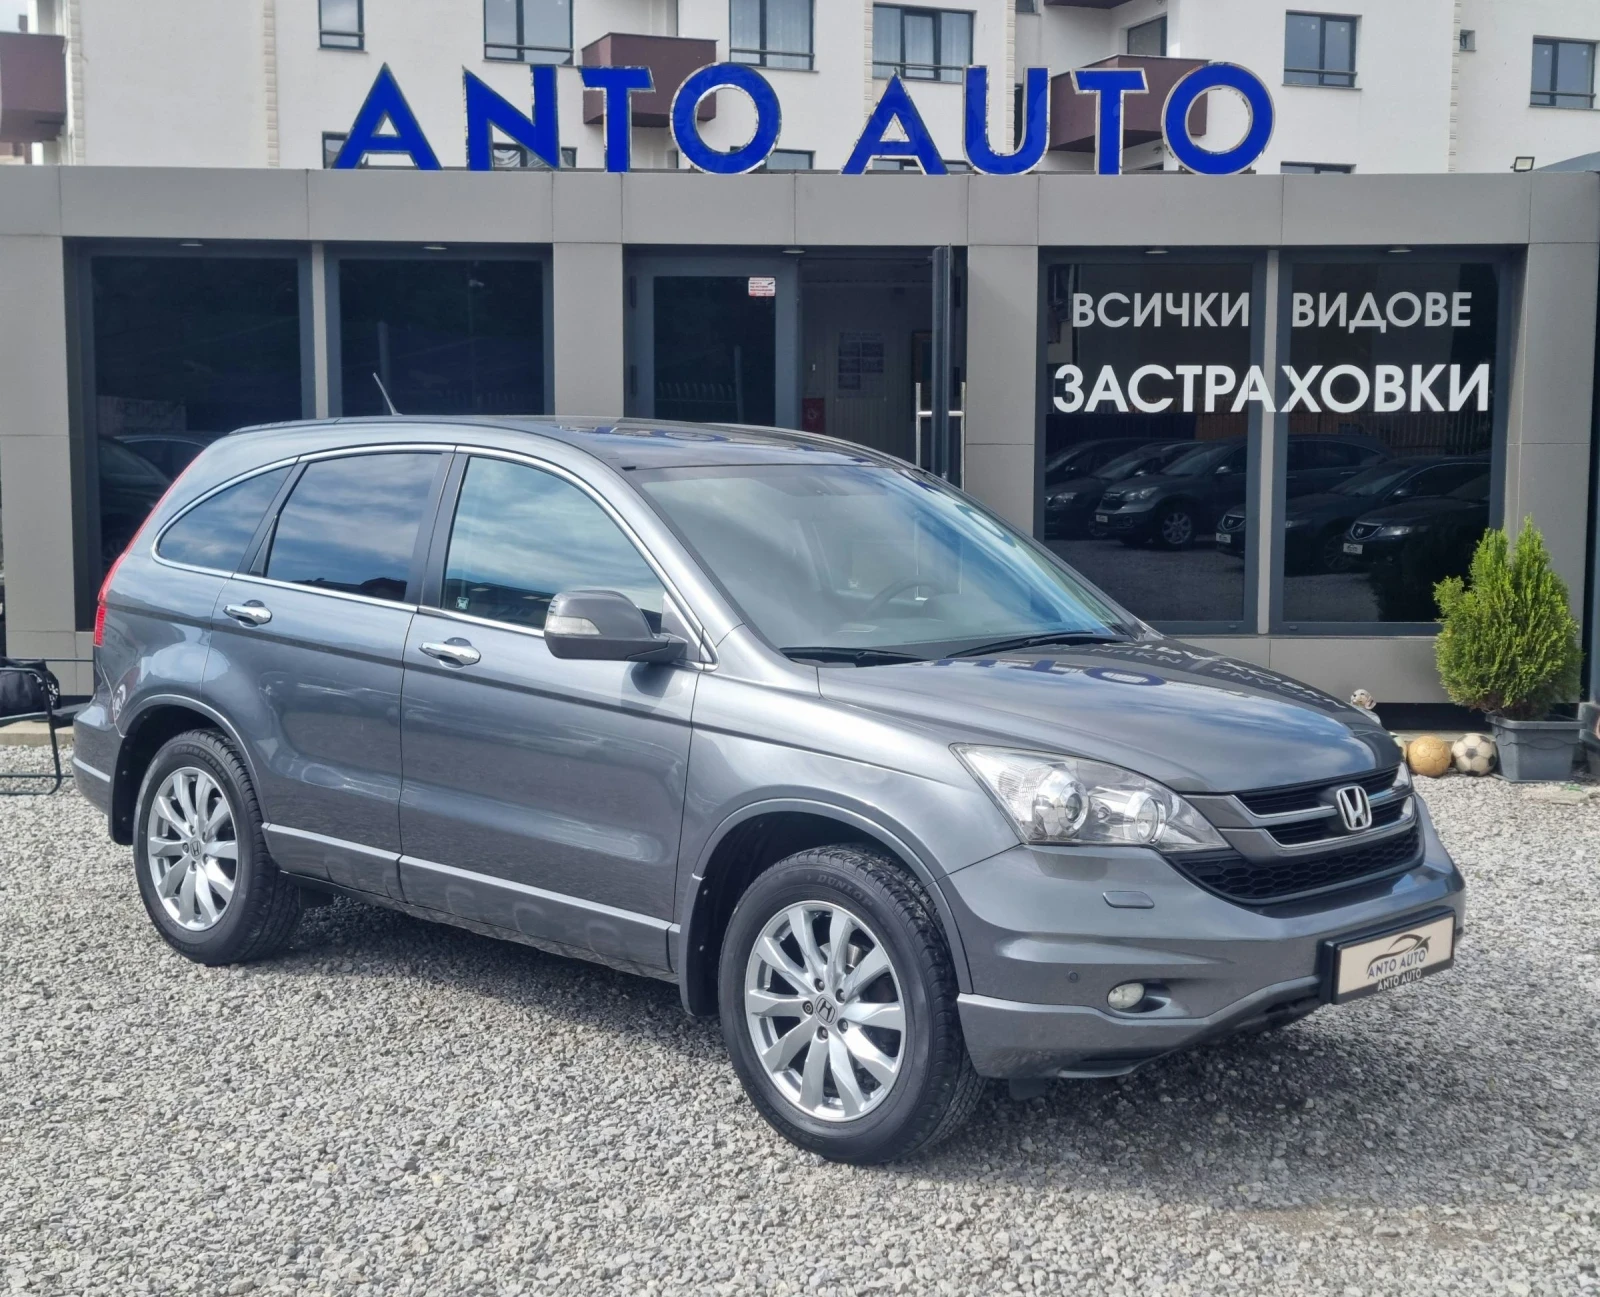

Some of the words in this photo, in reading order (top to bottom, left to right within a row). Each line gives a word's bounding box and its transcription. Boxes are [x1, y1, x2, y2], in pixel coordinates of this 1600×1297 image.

[331, 61, 782, 174] ANTO
[841, 61, 1276, 175] AUTO
[1071, 291, 1250, 328] ВСИЧКИ
[1291, 291, 1472, 334] ВИДОВЕ
[1053, 364, 1490, 413] ЗАСТРАХОВКИ
[1368, 959, 1397, 978] ANTO
[1401, 949, 1426, 968] AUTO
[1377, 976, 1399, 992] ANTO
[1401, 968, 1422, 985] AUTO
